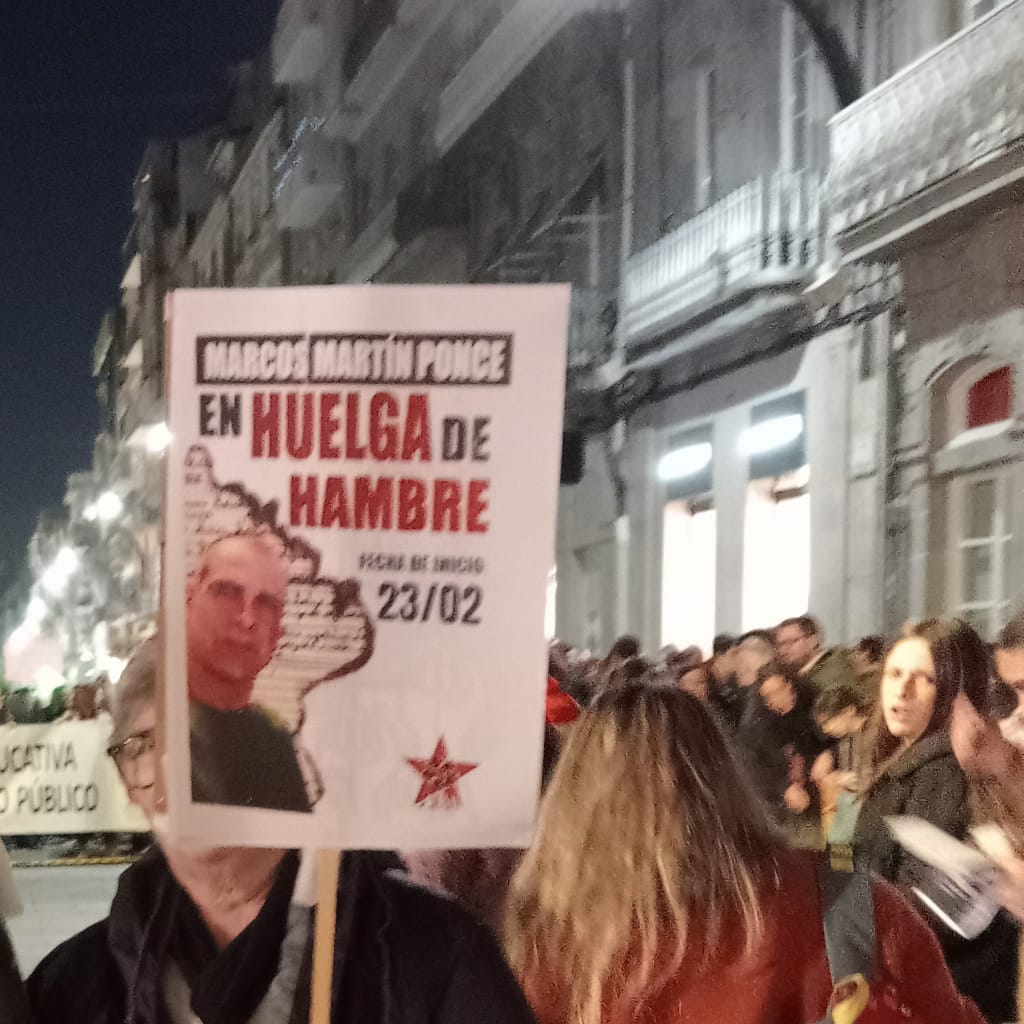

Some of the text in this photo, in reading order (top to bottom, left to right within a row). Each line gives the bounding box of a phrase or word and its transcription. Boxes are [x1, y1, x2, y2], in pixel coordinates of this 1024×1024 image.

[203, 333, 507, 382] MARCOS MARTÍN PONCE
[199, 391, 491, 462] EN HUELGA DE
[289, 473, 491, 534] HAMBRE
[378, 582, 483, 625] 23/02
[17, 778, 99, 814] PÚBLICO
